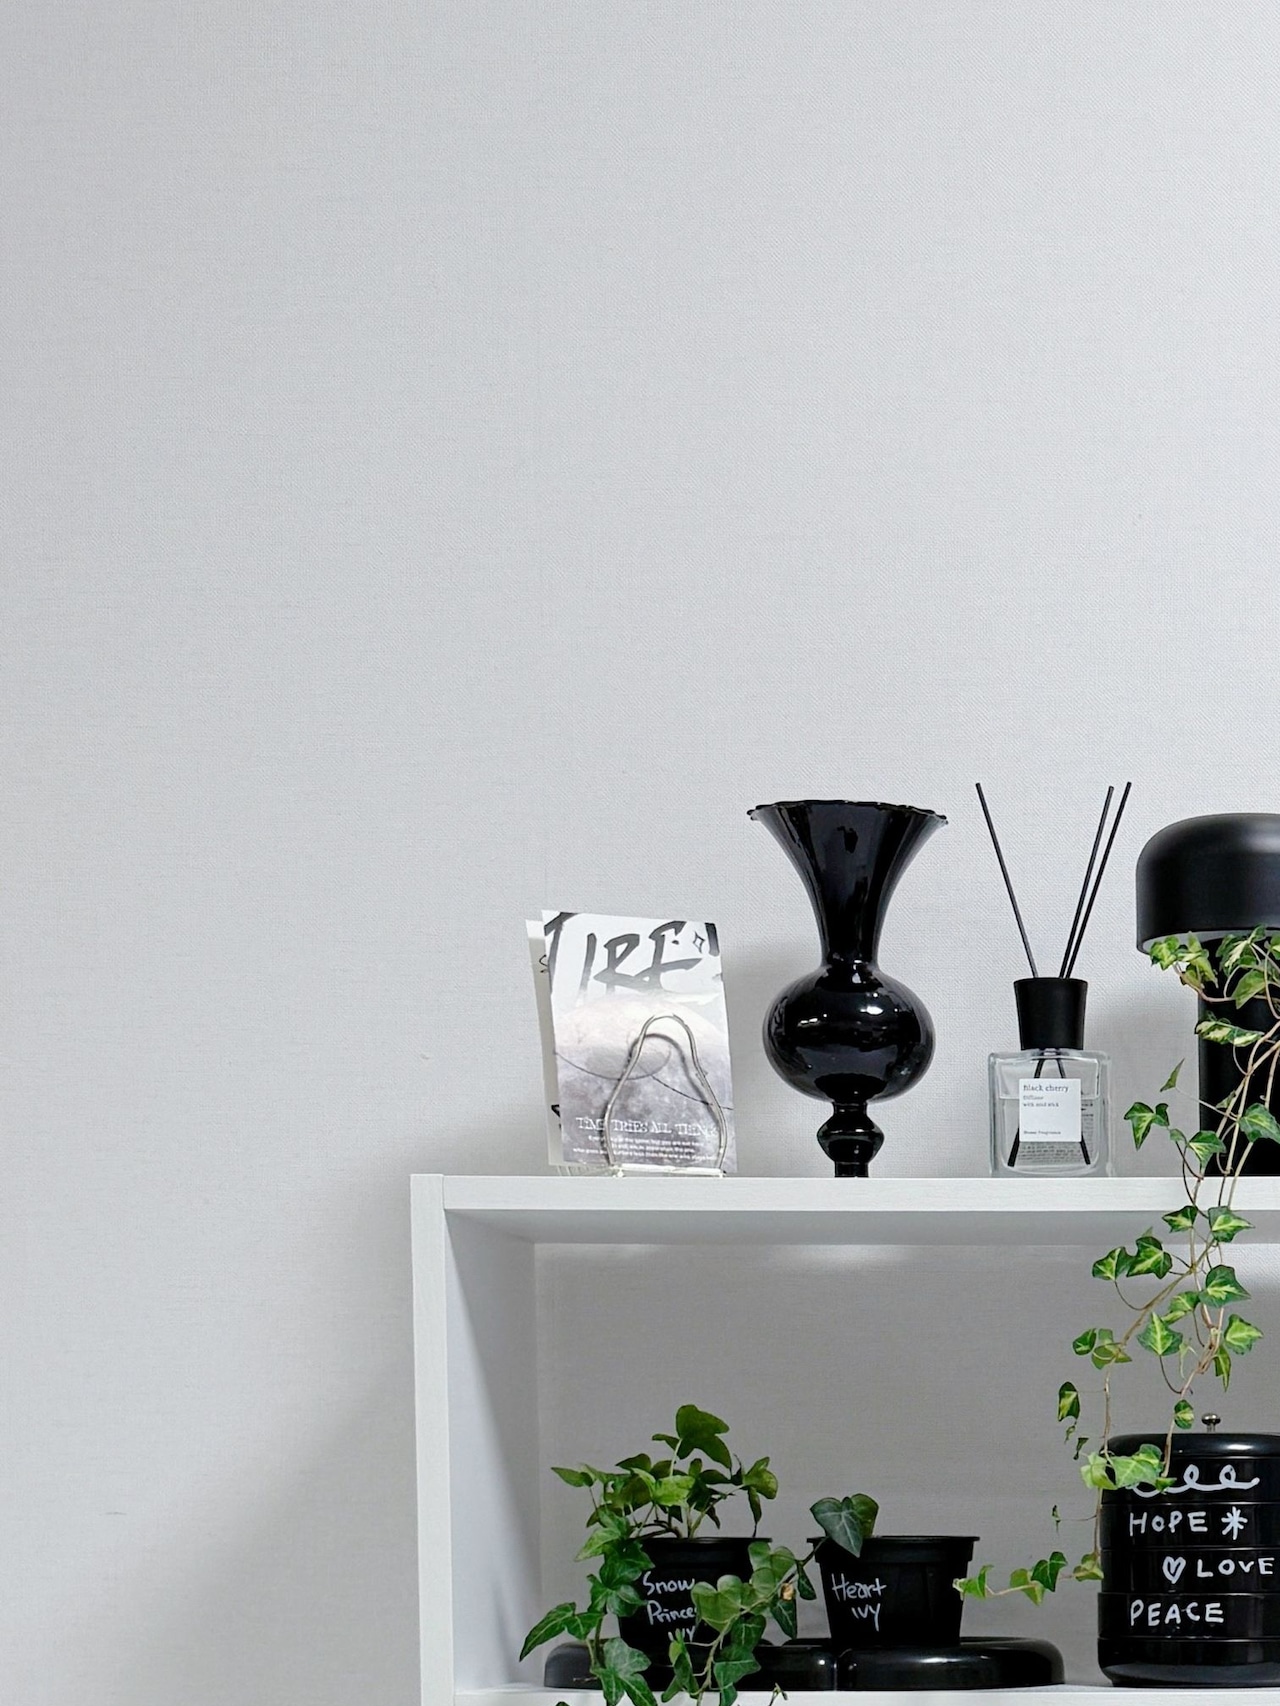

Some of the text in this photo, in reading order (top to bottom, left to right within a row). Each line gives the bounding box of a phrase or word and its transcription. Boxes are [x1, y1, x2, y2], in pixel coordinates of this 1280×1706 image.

[1045, 1084, 1069, 1093] cherry
[1129, 1510, 1208, 1537] HOPE
[1197, 1557, 1275, 1578] LOVE
[642, 1570, 695, 1596] Snow
[831, 1572, 888, 1602] Heart
[1130, 1599, 1224, 1626] PEACE
